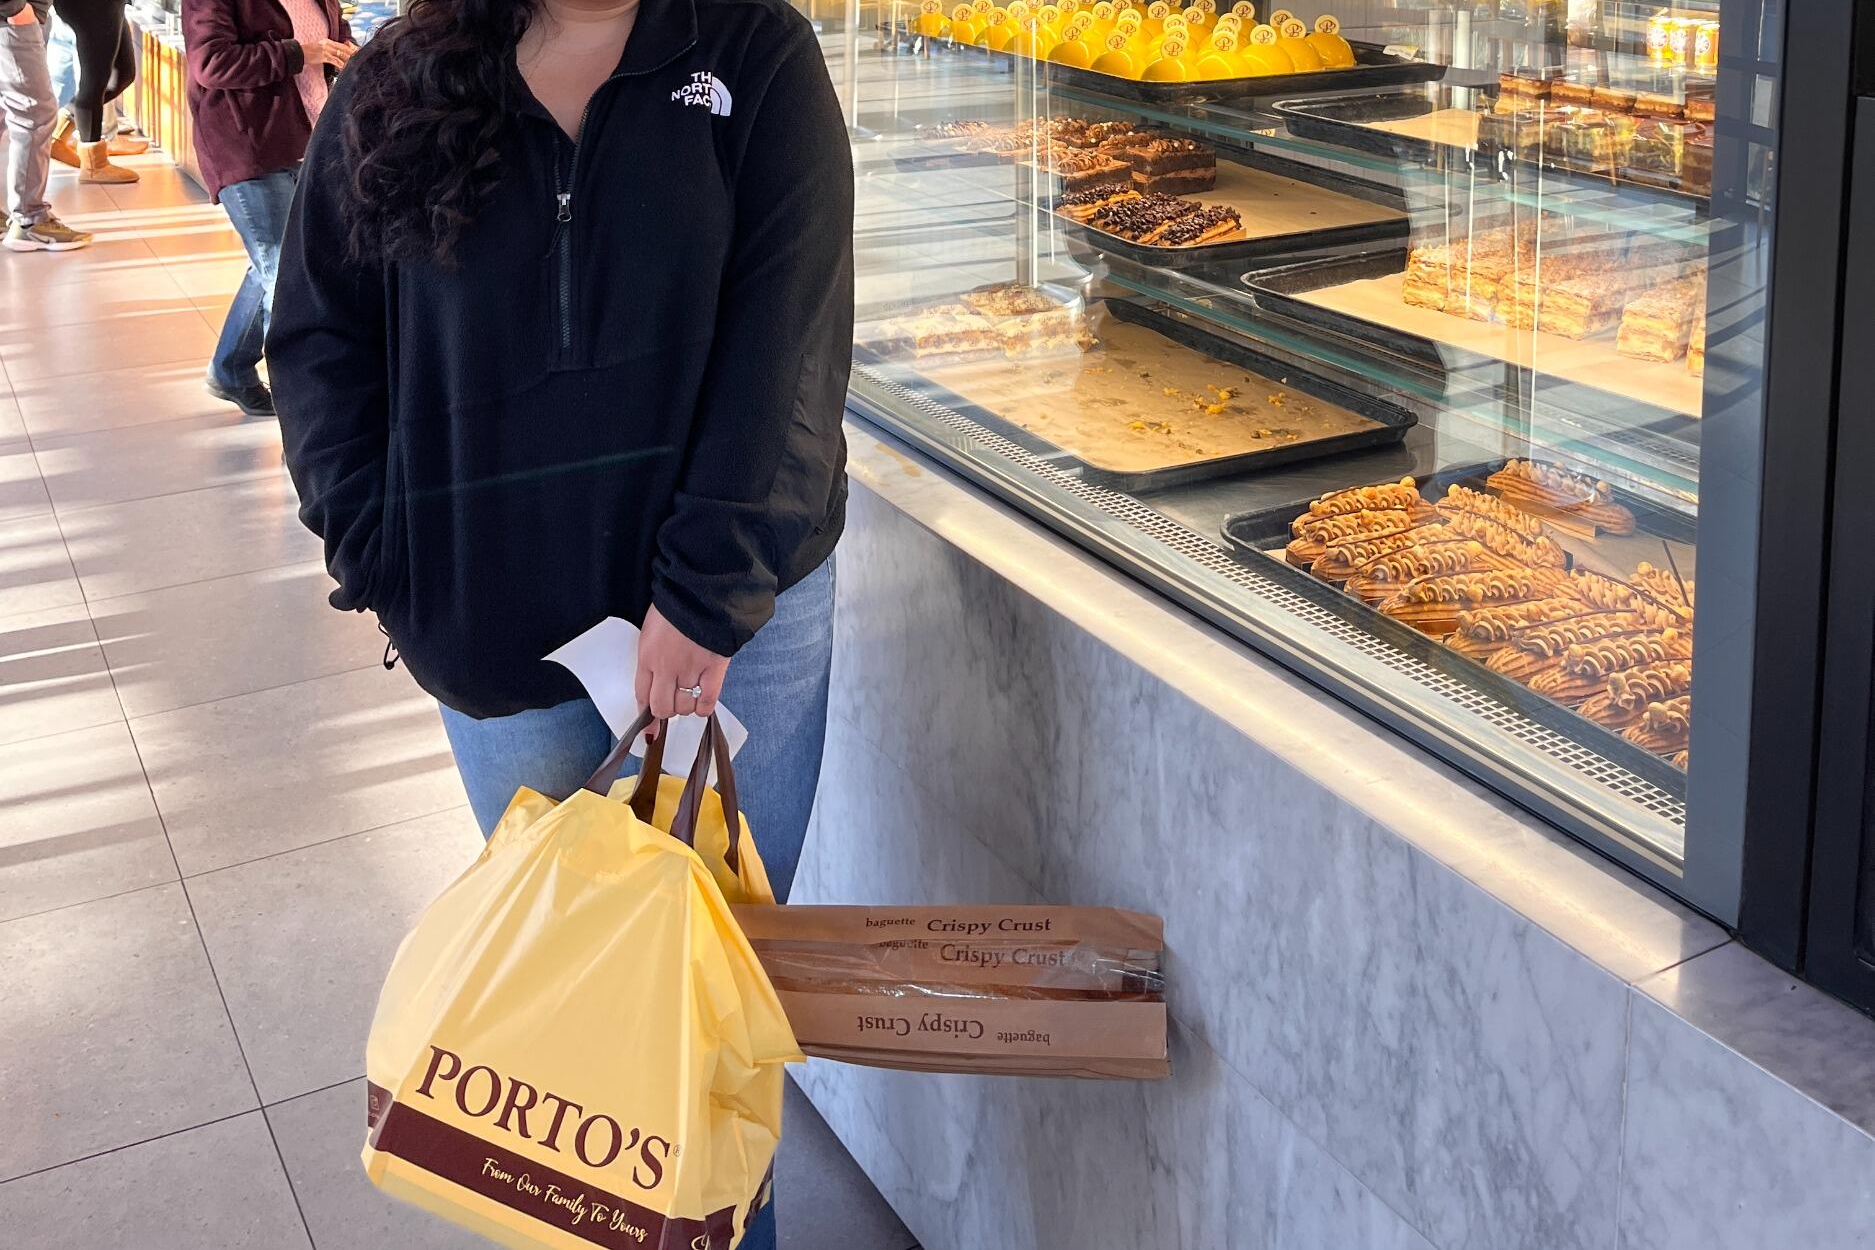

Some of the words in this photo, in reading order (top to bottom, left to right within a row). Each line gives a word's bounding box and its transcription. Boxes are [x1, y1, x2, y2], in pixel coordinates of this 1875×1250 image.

[690, 71, 712, 83] TH
[671, 82, 712, 101] NORT
[684, 94, 711, 107] FAC
[865, 917, 916, 929] baguette
[927, 919, 992, 934] Crispy
[998, 918, 1052, 931] Crust
[940, 943, 1004, 968] Crispy
[1011, 948, 1065, 966] Crust
[857, 1015, 911, 1036] Crust
[917, 1012, 984, 1039] Crispy
[997, 1029, 1051, 1046] baguette
[415, 1044, 671, 1190] PORTO'S
[482, 1157, 515, 1184] From
[516, 1173, 542, 1196] Our
[544, 1184, 588, 1225] Family
[590, 1202, 610, 1222] To
[609, 1209, 648, 1243] Yours
